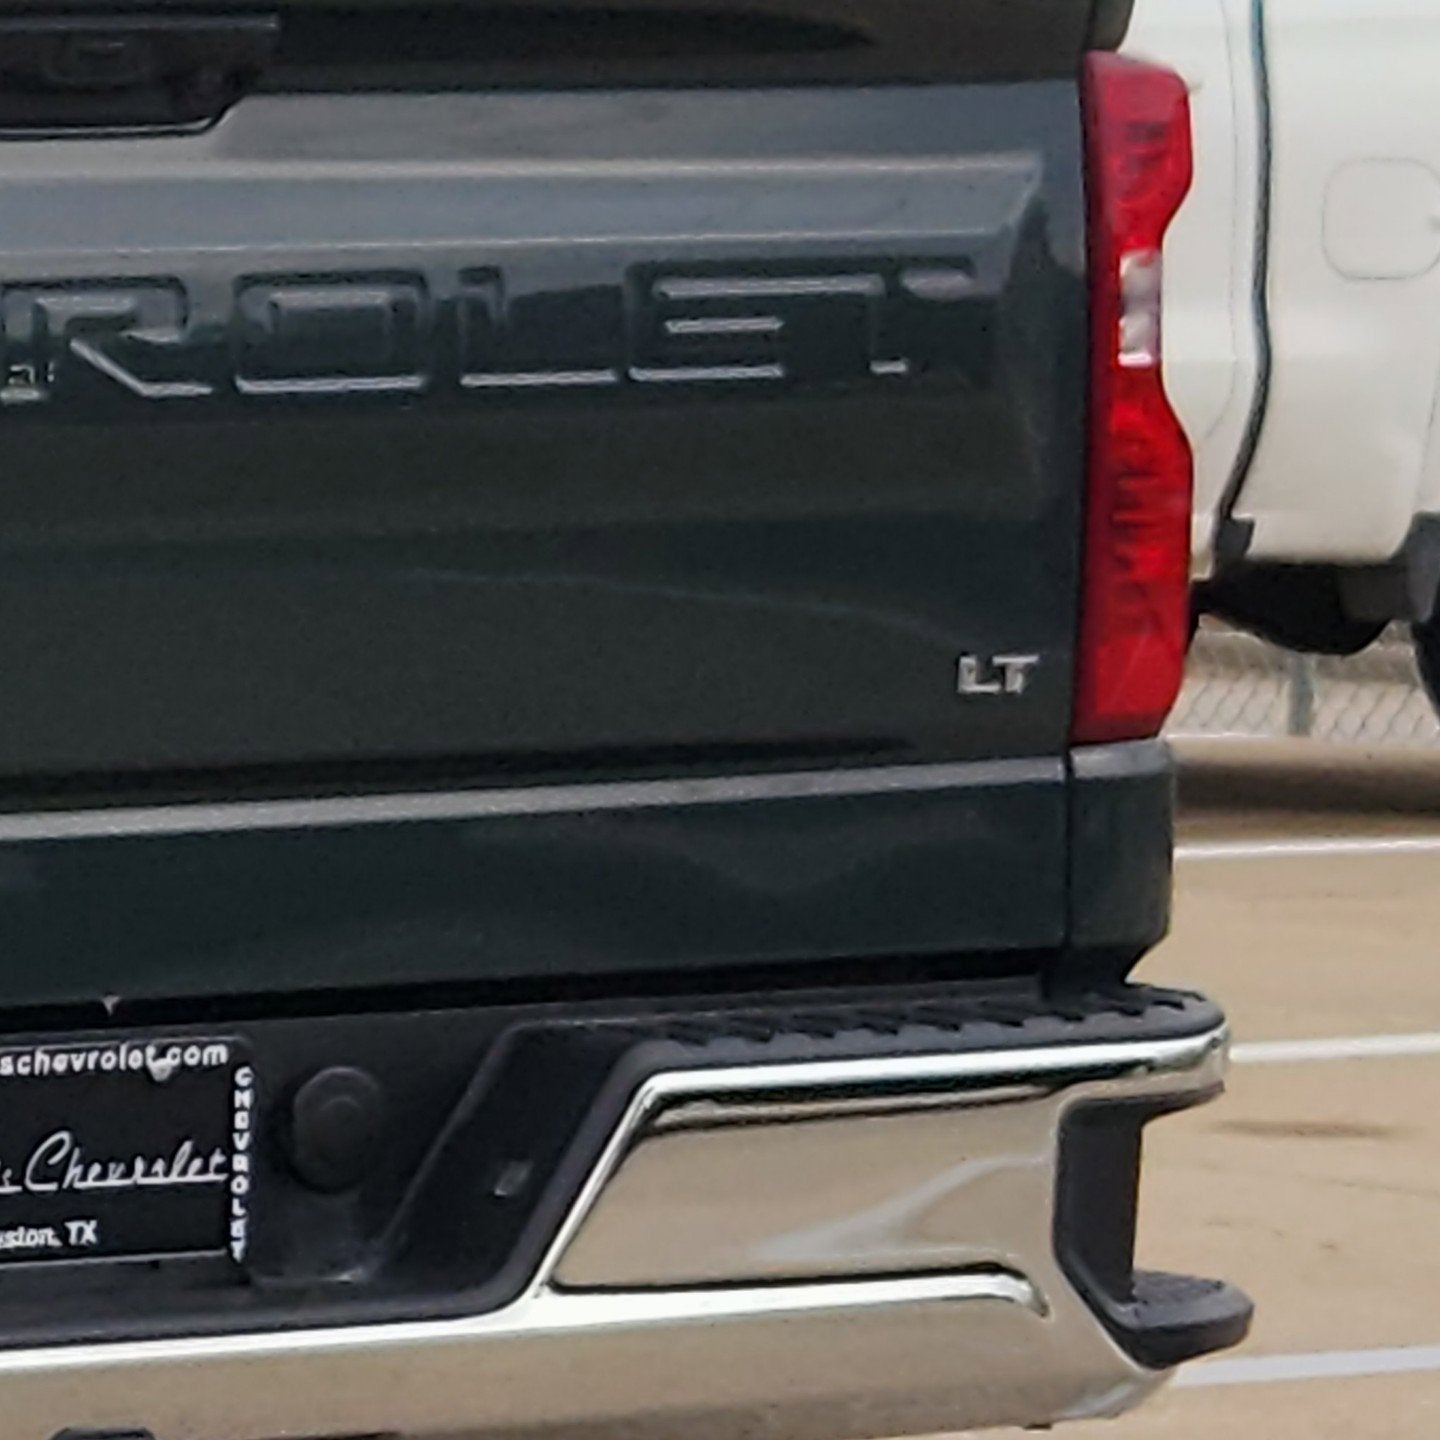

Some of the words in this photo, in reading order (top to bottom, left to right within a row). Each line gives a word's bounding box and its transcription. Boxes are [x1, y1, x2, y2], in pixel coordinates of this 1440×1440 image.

[957, 654, 1040, 694] LT
[25, 1130, 228, 1191] Chevrolet
[63, 1219, 98, 1246] TX
